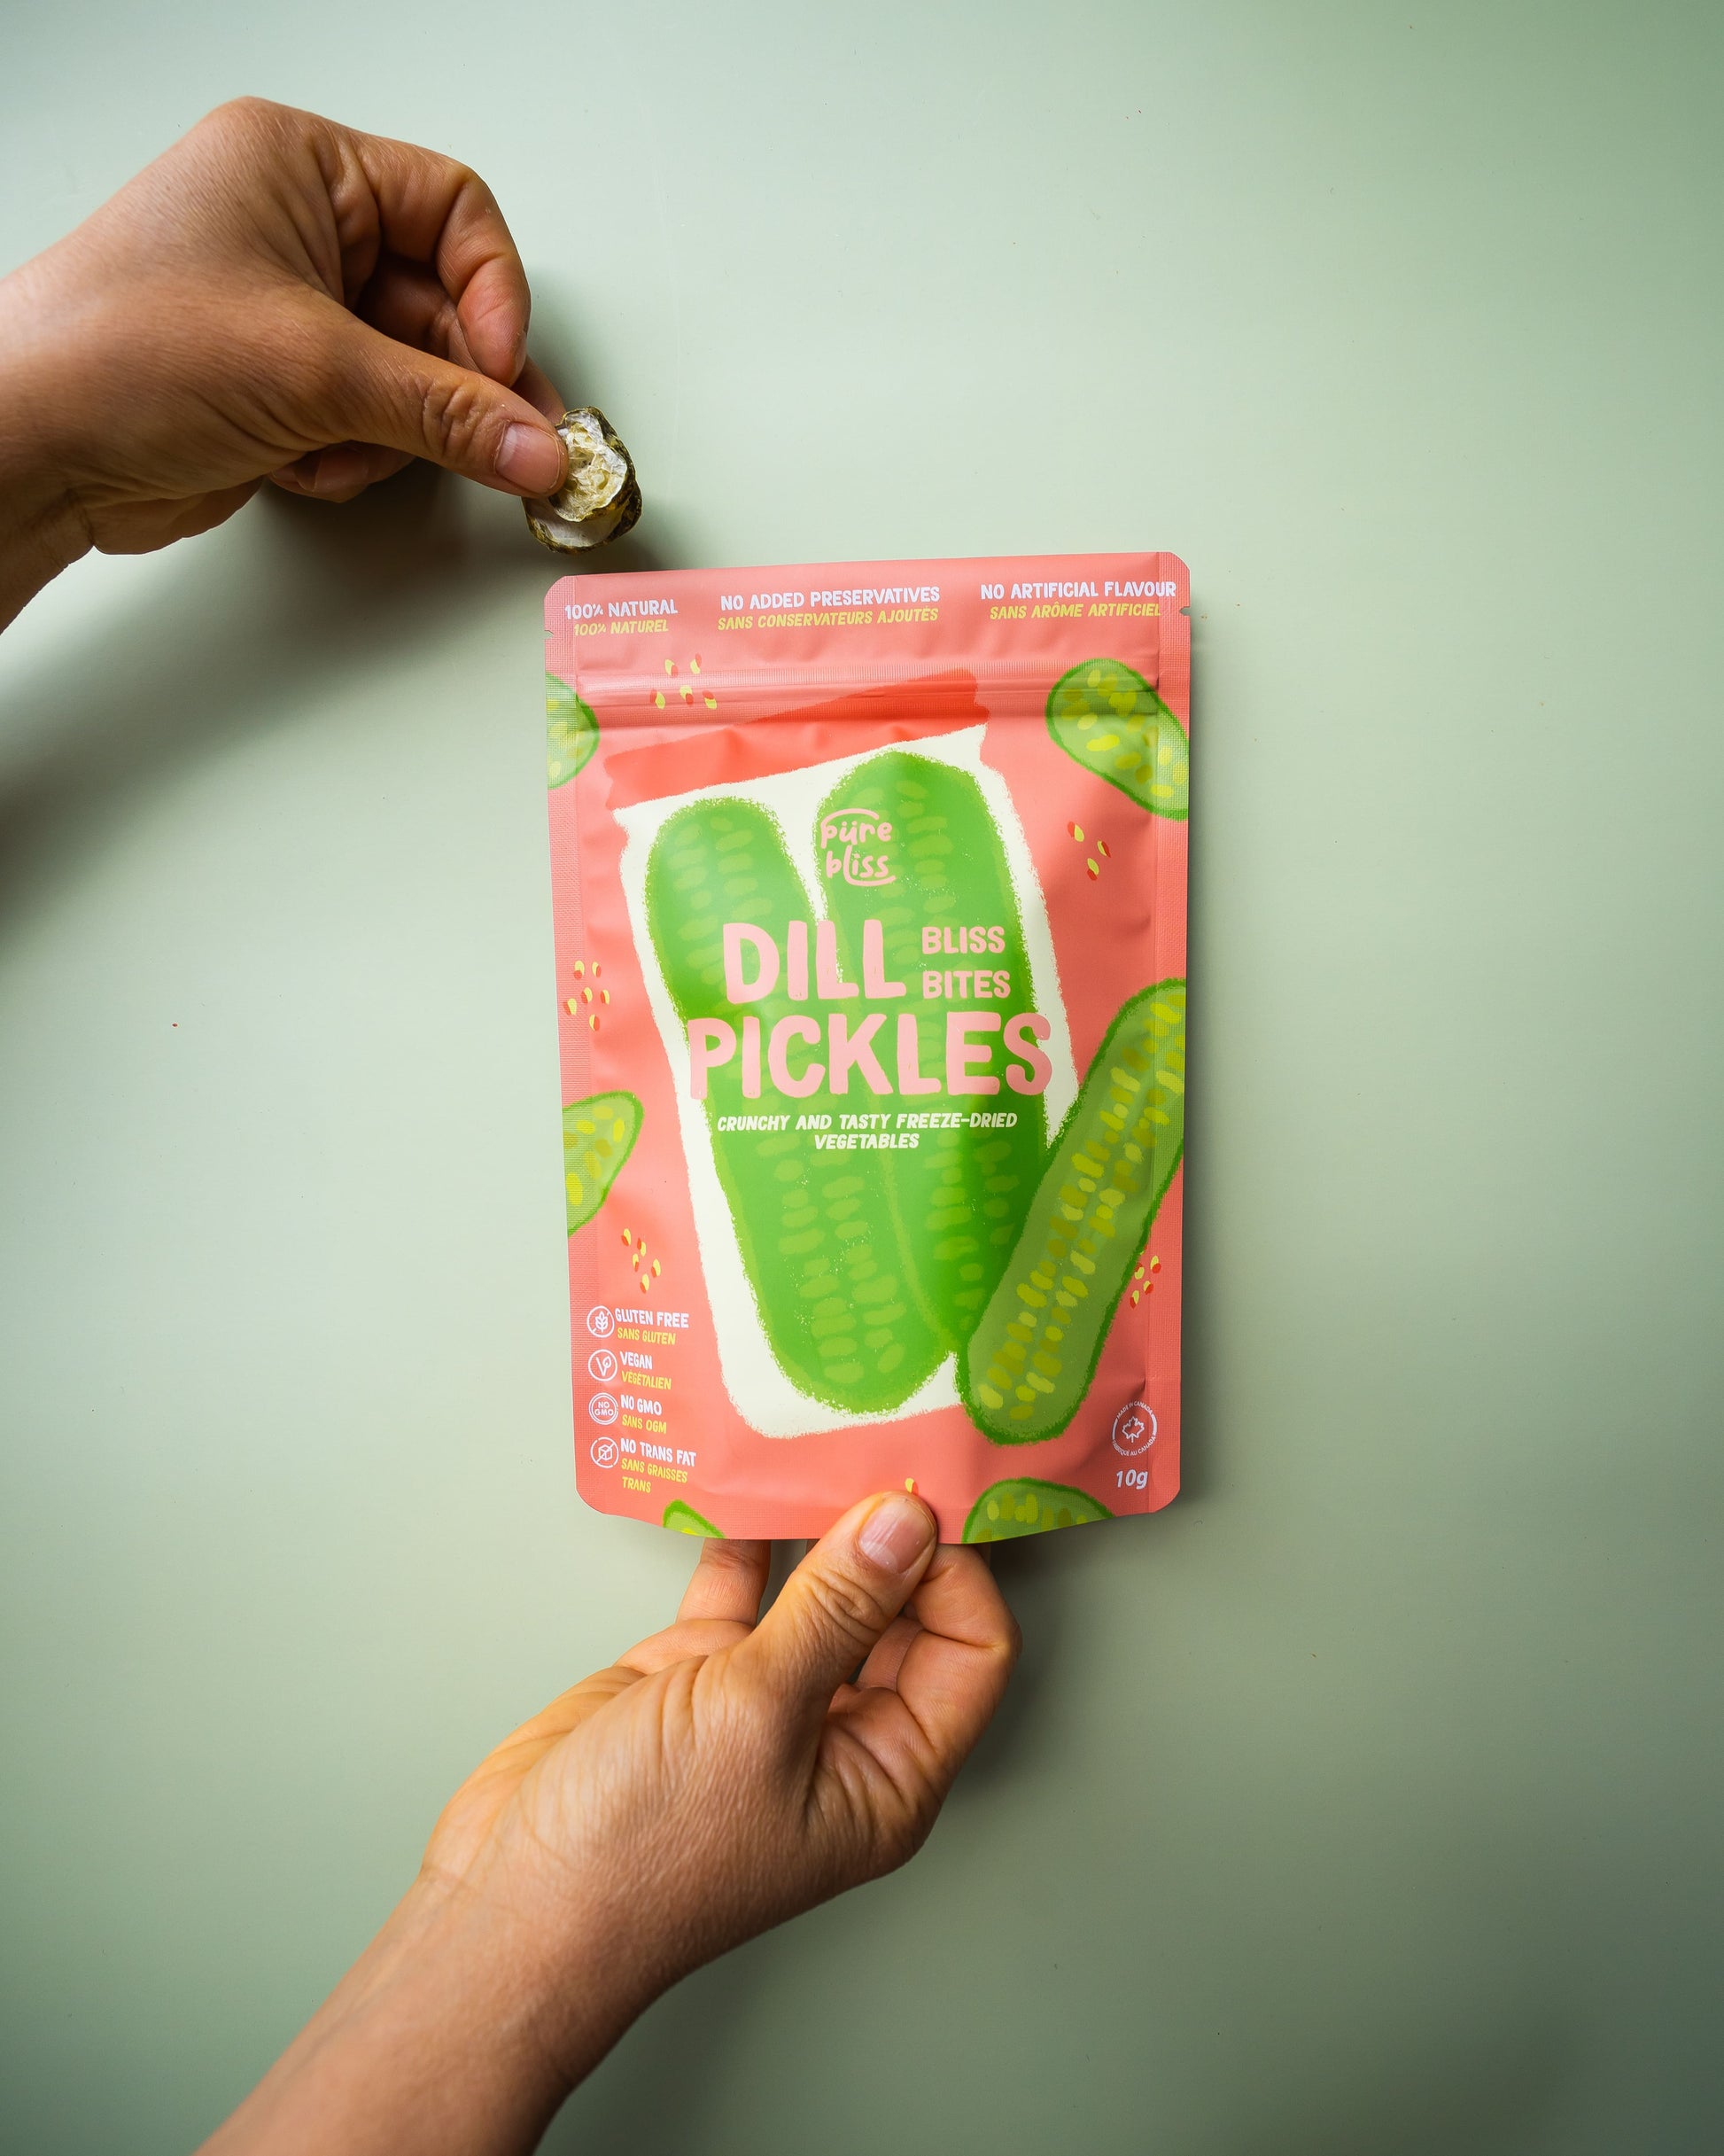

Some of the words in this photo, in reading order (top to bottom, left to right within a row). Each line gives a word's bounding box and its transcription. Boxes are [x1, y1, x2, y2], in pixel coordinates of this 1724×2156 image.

[720, 595, 743, 611] NO
[749, 593, 805, 610] ADDED
[810, 587, 941, 607] PRESERVATIVES
[981, 584, 1005, 600] NO
[1011, 582, 1099, 599] ARTIFICIAL
[1104, 581, 1177, 597] FLAVOUR
[564, 603, 604, 619] 100%
[608, 599, 679, 618] NATURAL
[718, 617, 753, 631] SANS
[757, 611, 873, 628] CONSERVATEURS
[877, 606, 939, 623] AJOUTÉS
[990, 606, 1027, 619] SANS
[1031, 601, 1083, 619] ARÔME
[1087, 603, 1161, 618] ARTIFICIEL
[574, 623, 607, 636] 100%
[610, 619, 669, 634] NATUREL
[826, 844, 897, 886] bliss
[921, 926, 1006, 954] BLISS
[722, 919, 906, 1004] DILL
[922, 970, 1011, 999] BITES
[687, 1011, 1052, 1100] PICKLES
[717, 1115, 791, 1132] CRUNCHY
[796, 1114, 832, 1130] AND
[839, 1114, 891, 1129] TASTY
[896, 1112, 1018, 1128] FREEZE-DRIED
[814, 1132, 920, 1149] VEGETABLES
[614, 1308, 653, 1325] GLUTEN
[656, 1312, 689, 1328] FREE
[617, 1327, 640, 1341] SANS
[642, 1330, 676, 1345] GLUTEN
[620, 1351, 653, 1370] VEGAN
[621, 1370, 672, 1390] VÉGÉTALIEN
[620, 1395, 634, 1410] NO
[637, 1398, 663, 1416] GMO
[1133, 1400, 1153, 1416] CANADA
[622, 1414, 643, 1429] SANS
[646, 1419, 667, 1434] OGM
[620, 1437, 636, 1454] NO
[640, 1441, 673, 1463] TRANS
[676, 1451, 696, 1467] FAT
[1138, 1436, 1156, 1455] CANADA
[621, 1458, 645, 1474] SANS
[647, 1463, 687, 1483] GRAISSES
[1116, 1468, 1149, 1490] 10g
[622, 1476, 651, 1493] TRANS
